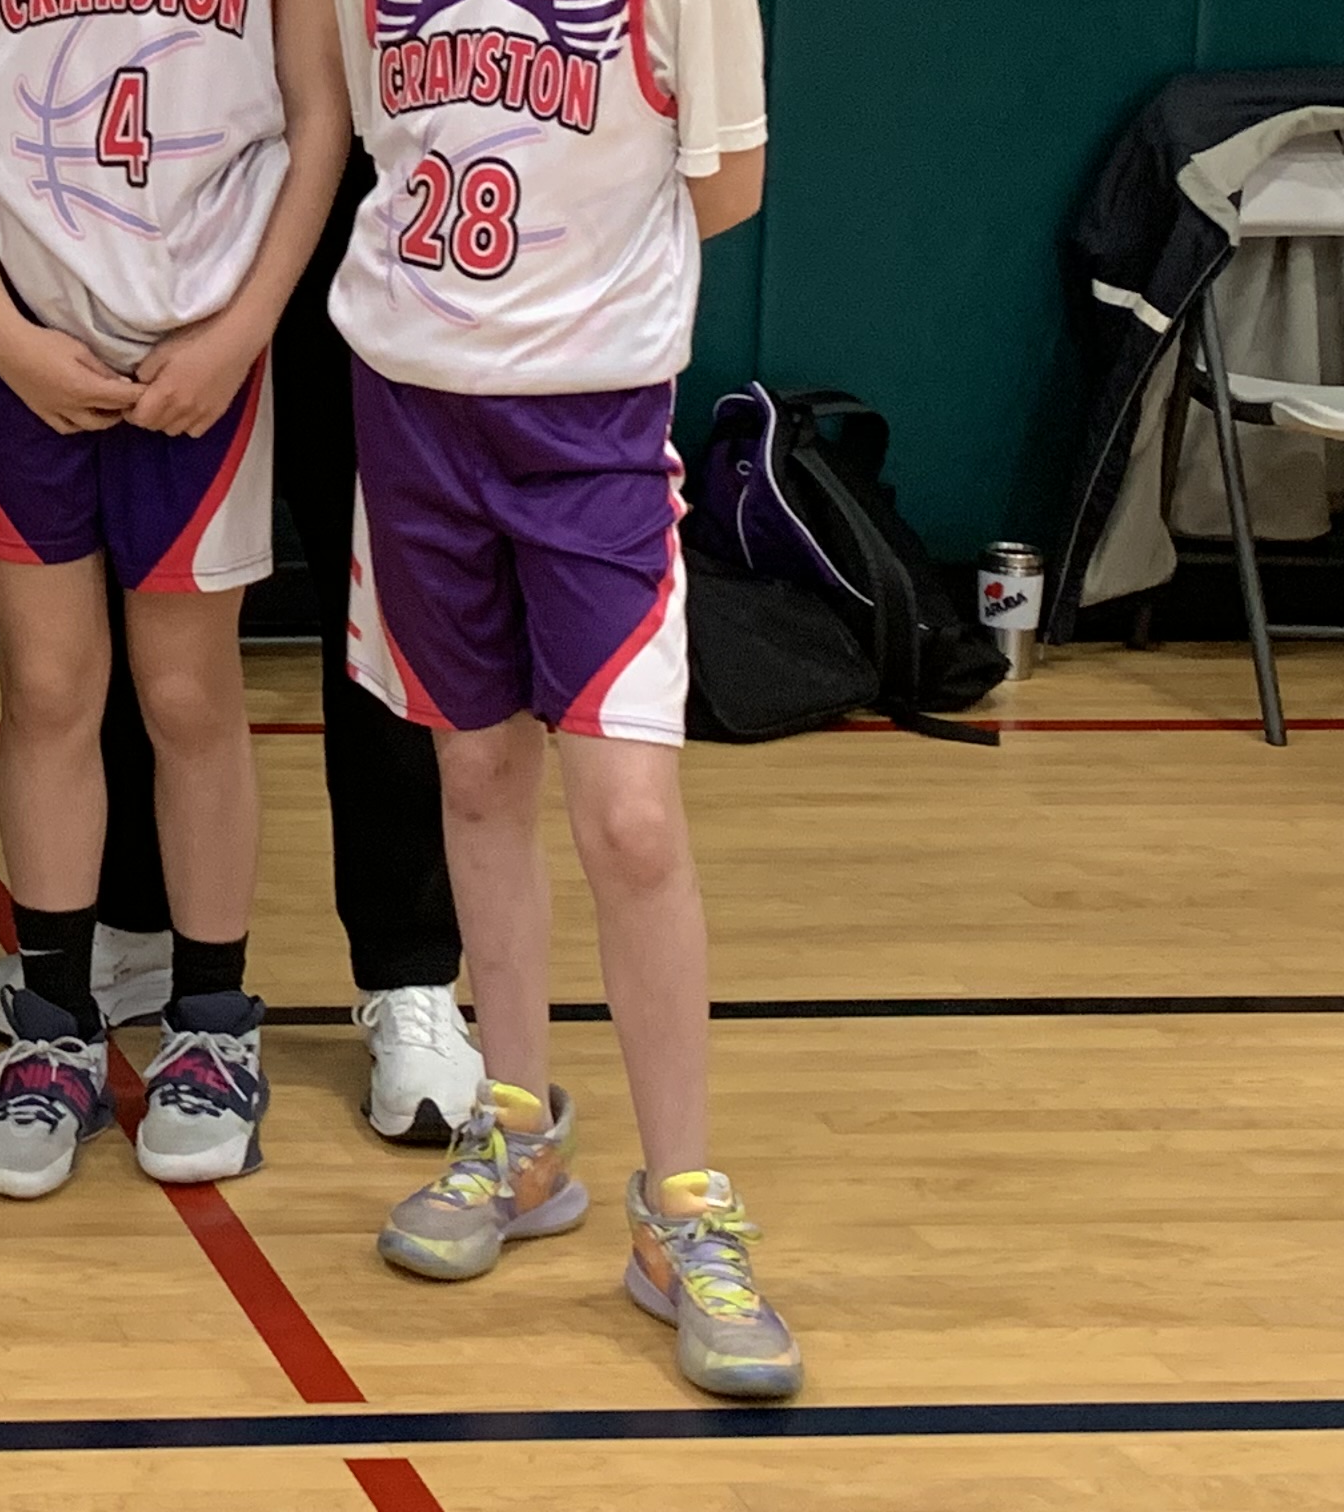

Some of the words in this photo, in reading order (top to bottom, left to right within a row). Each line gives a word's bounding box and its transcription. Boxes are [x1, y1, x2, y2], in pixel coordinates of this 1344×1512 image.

[96, 65, 154, 188] 4
[379, 27, 602, 135] CRANSTON
[399, 149, 522, 280] 28
